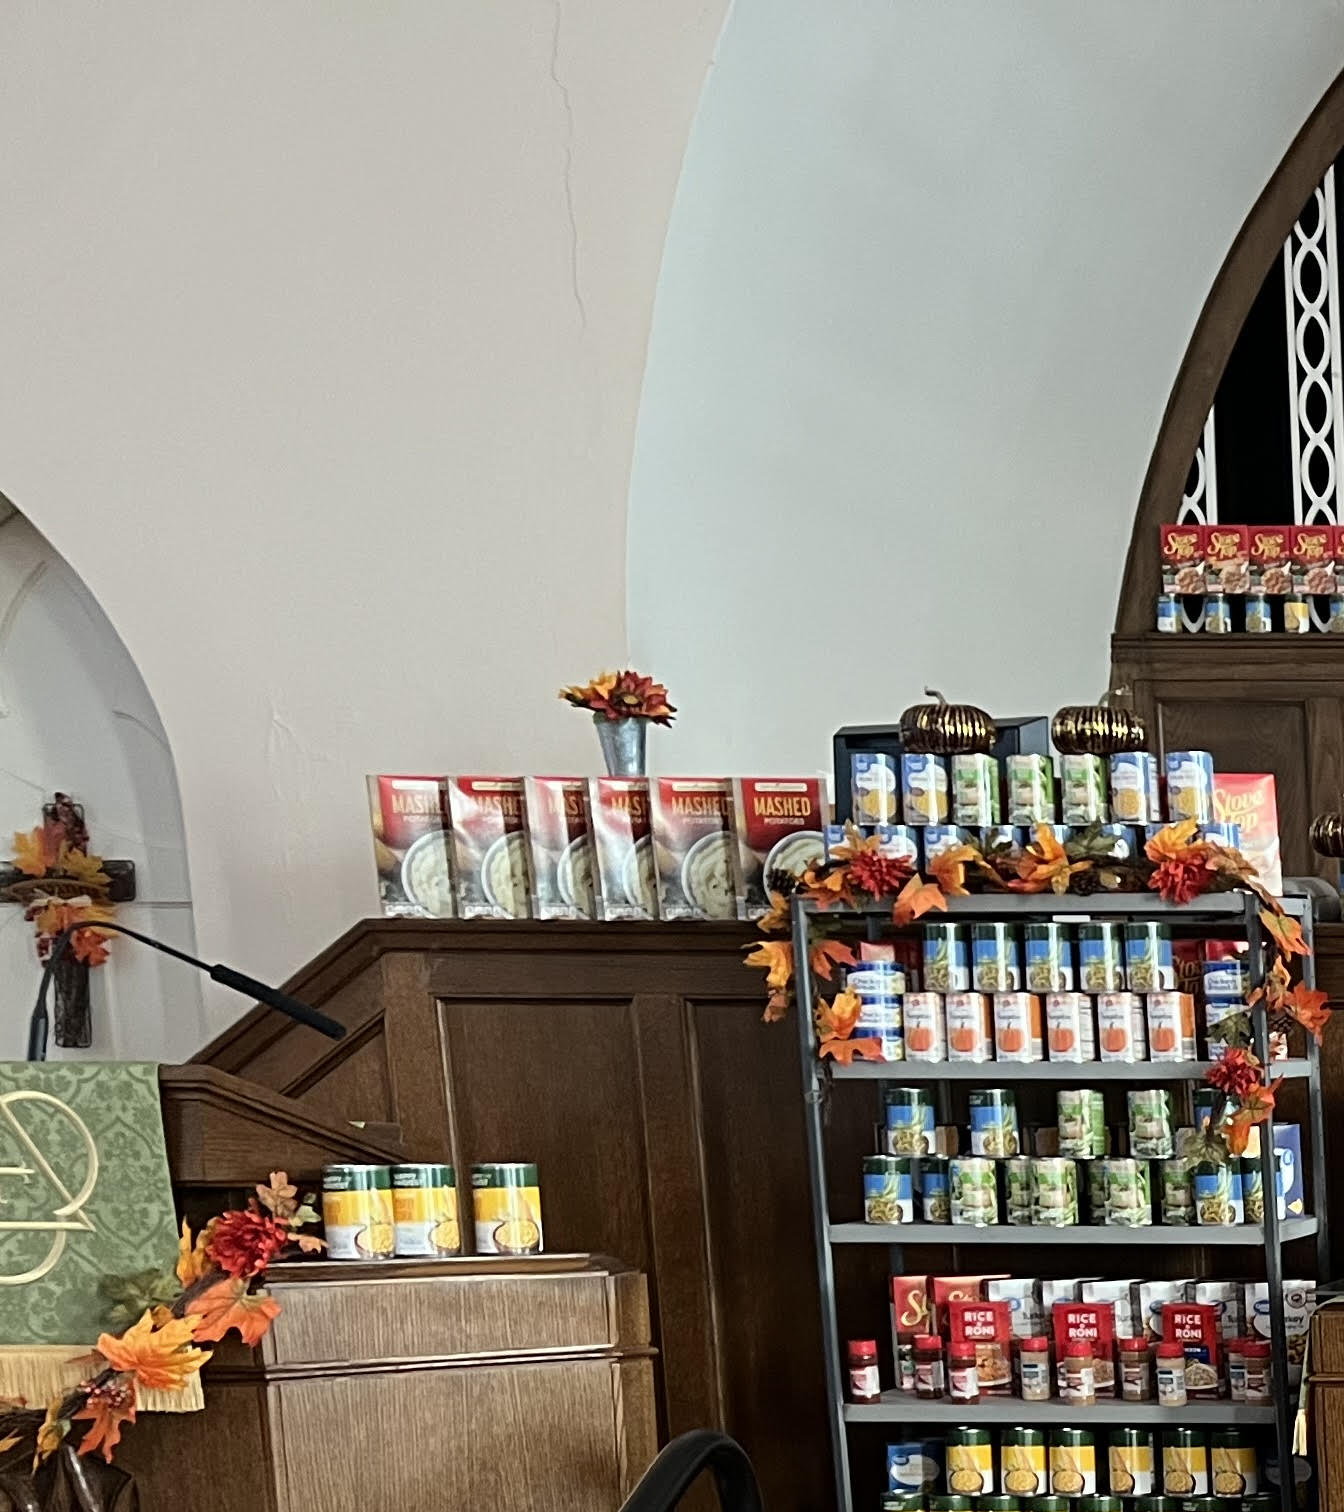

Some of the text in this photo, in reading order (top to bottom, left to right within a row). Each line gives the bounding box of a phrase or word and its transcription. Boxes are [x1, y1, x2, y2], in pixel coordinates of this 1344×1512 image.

[754, 798, 811, 818] MASHED
[964, 1311, 994, 1323] RICE
[1067, 1313, 1097, 1325] RICE
[1174, 1313, 1202, 1325] RICE
